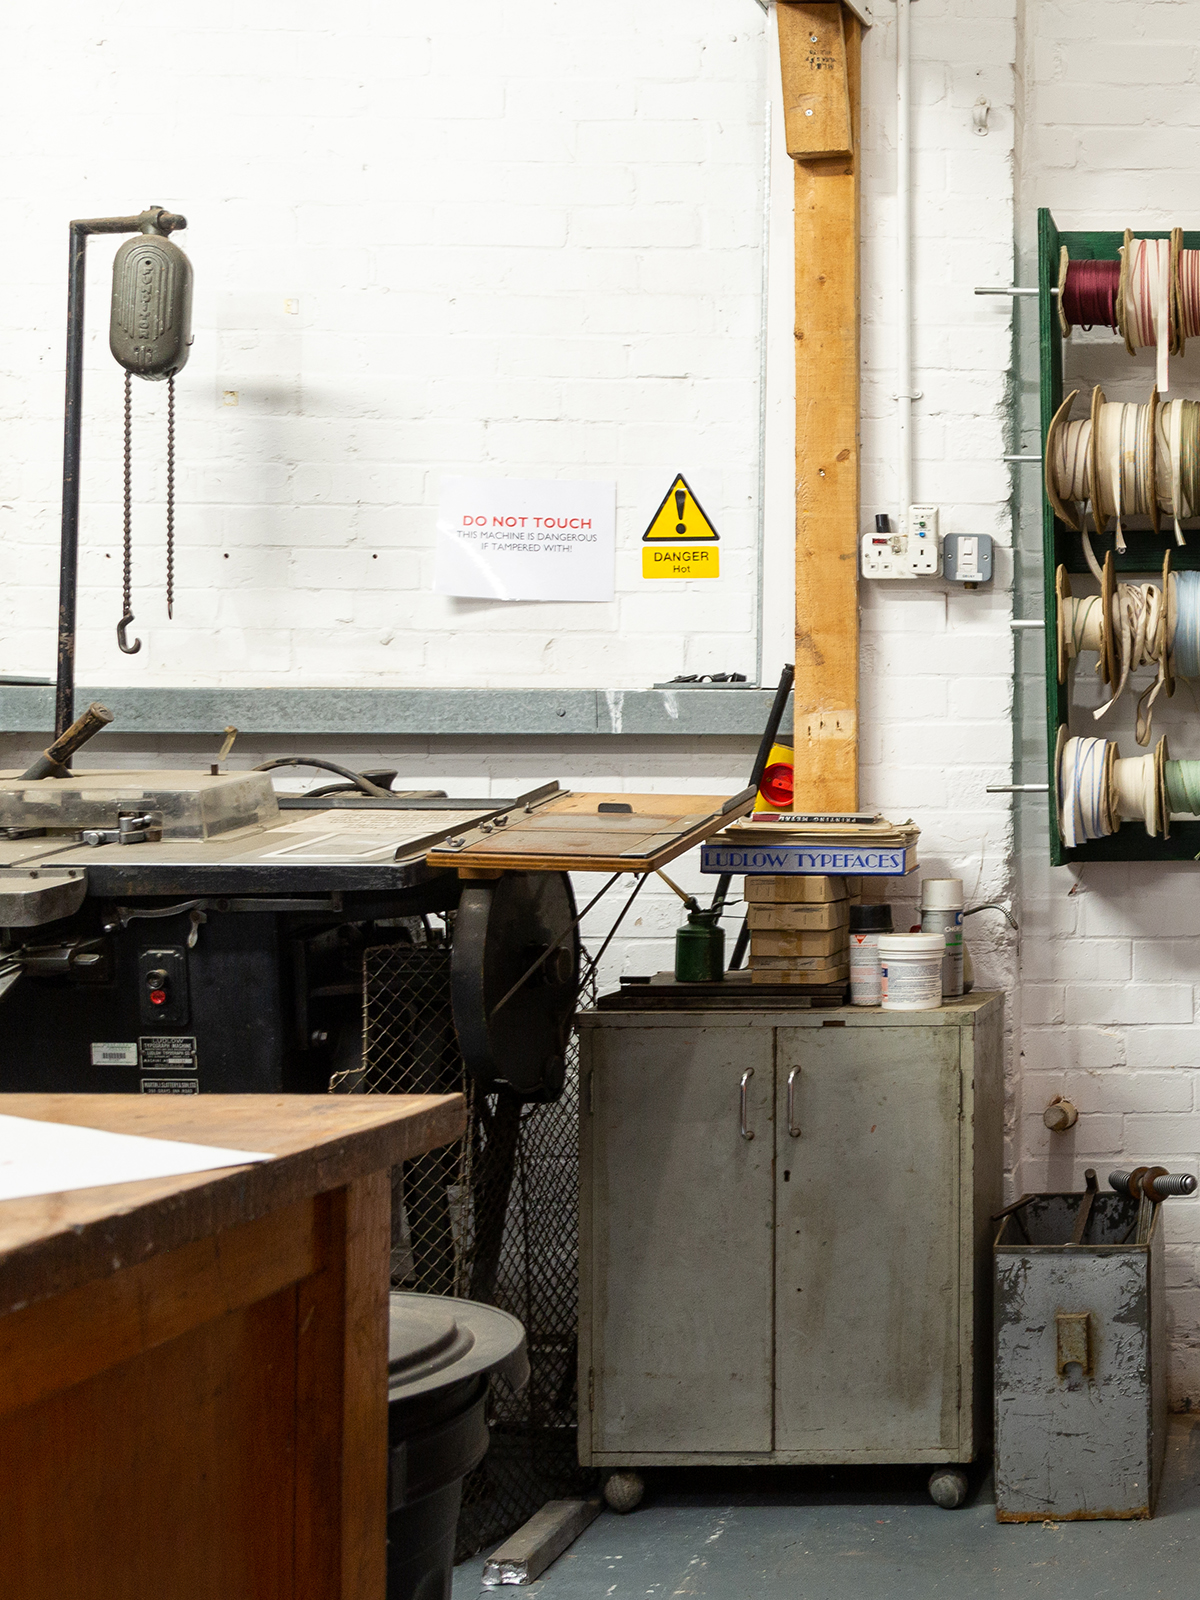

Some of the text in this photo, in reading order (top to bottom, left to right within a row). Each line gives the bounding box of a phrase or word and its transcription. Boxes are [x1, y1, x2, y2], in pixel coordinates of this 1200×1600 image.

[462, 515, 592, 529] DO NOT TOUCH
[457, 530, 598, 543] THIS MACHINE IS DANGEROUS
[481, 543, 573, 553] IF TAMPERED WITH!
[653, 551, 710, 562] DANGER
[673, 565, 691, 573] Hot
[704, 852, 900, 868] LUDLOW TYPEFACES
